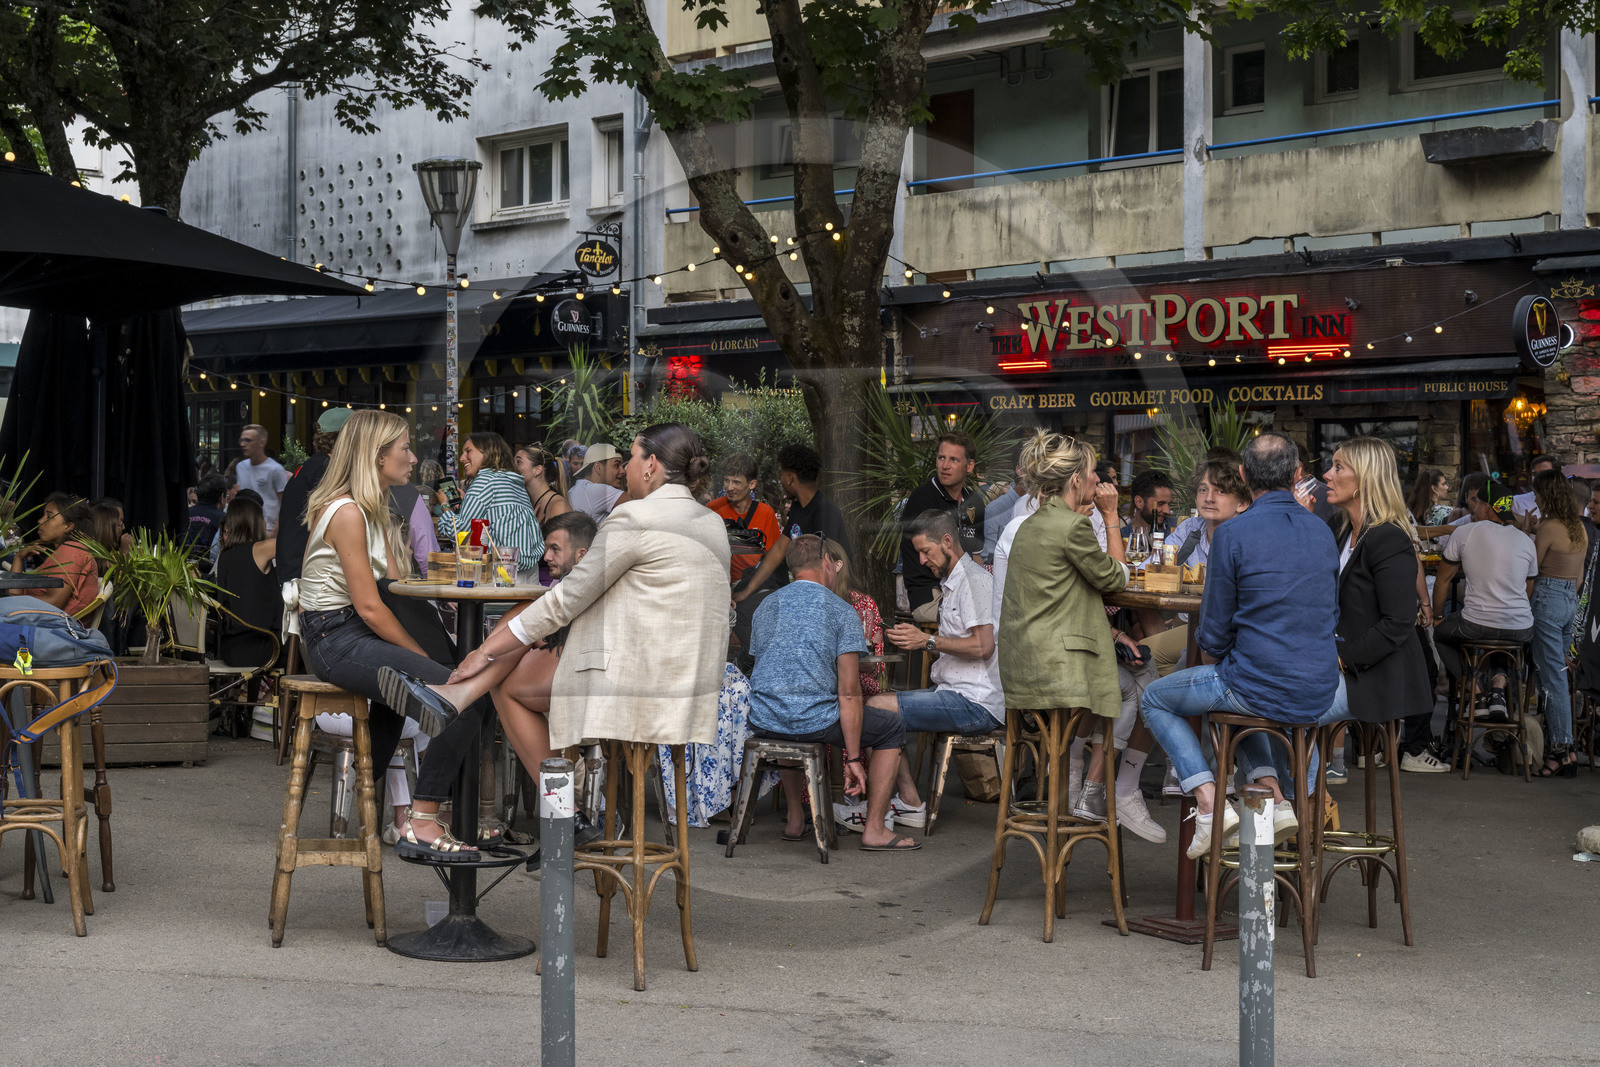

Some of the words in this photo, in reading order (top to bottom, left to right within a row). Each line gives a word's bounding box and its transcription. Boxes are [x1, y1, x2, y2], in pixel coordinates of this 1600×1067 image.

[558, 321, 590, 334] GUINNESS
[990, 334, 1023, 355] THE
[1018, 294, 1299, 352] WESTPORT
[1302, 314, 1347, 338] INN
[719, 337, 759, 350] LORCÁIN
[1531, 335, 1557, 350] GUINNESS
[1424, 382, 1466, 393] PUBLIC
[1468, 380, 1508, 392] HOUSE
[990, 394, 1035, 410] CRAFT
[1038, 393, 1076, 408] BEER
[1090, 389, 1166, 407] GOURMET
[1170, 388, 1214, 404] FOOD
[1228, 384, 1324, 402] COCKTAILS
